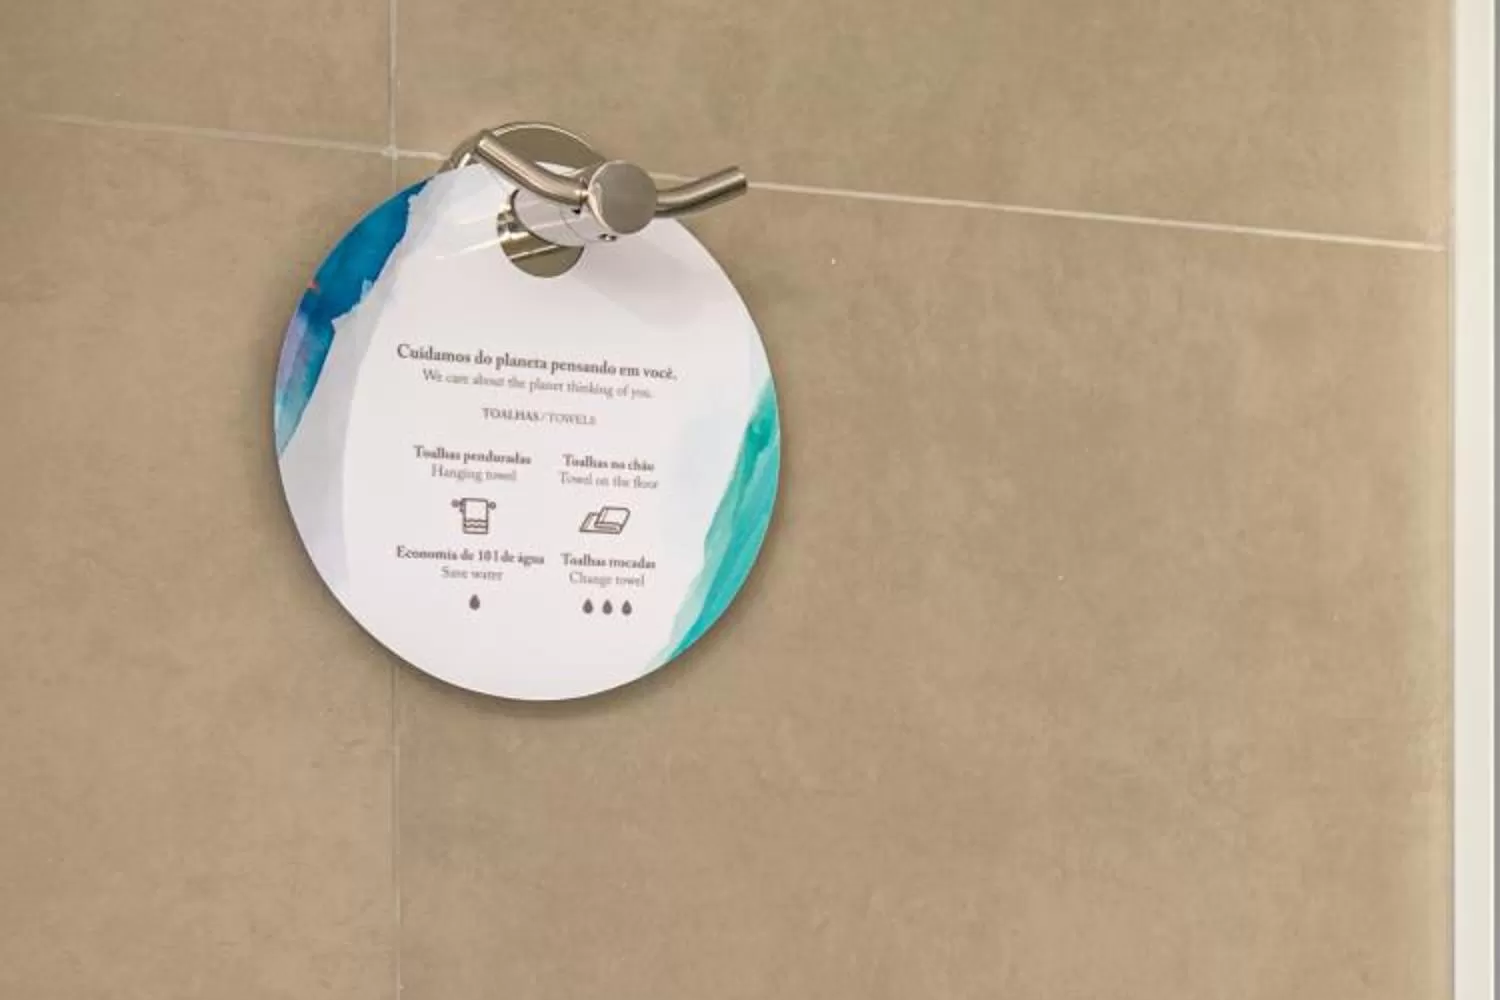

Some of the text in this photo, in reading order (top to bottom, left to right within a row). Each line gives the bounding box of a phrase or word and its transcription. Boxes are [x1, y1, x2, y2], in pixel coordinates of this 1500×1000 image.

[397, 344, 471, 364] Cuidamos
[474, 350, 493, 366] do
[495, 352, 548, 371] planeta
[550, 359, 617, 376] pensando
[619, 365, 641, 377] em
[422, 369, 443, 383] We
[472, 372, 505, 388] about
[529, 378, 564, 393] planet
[567, 380, 613, 399] thinking
[616, 385, 629, 397] of
[413, 446, 462, 461] Toalhas
[563, 454, 609, 469] Toalhas
[431, 464, 484, 483] Hanging
[397, 545, 459, 561] Economia
[460, 547, 476, 561] de
[500, 550, 517, 564] de
[560, 552, 607, 567] Toalhas
[569, 570, 613, 588] Change
